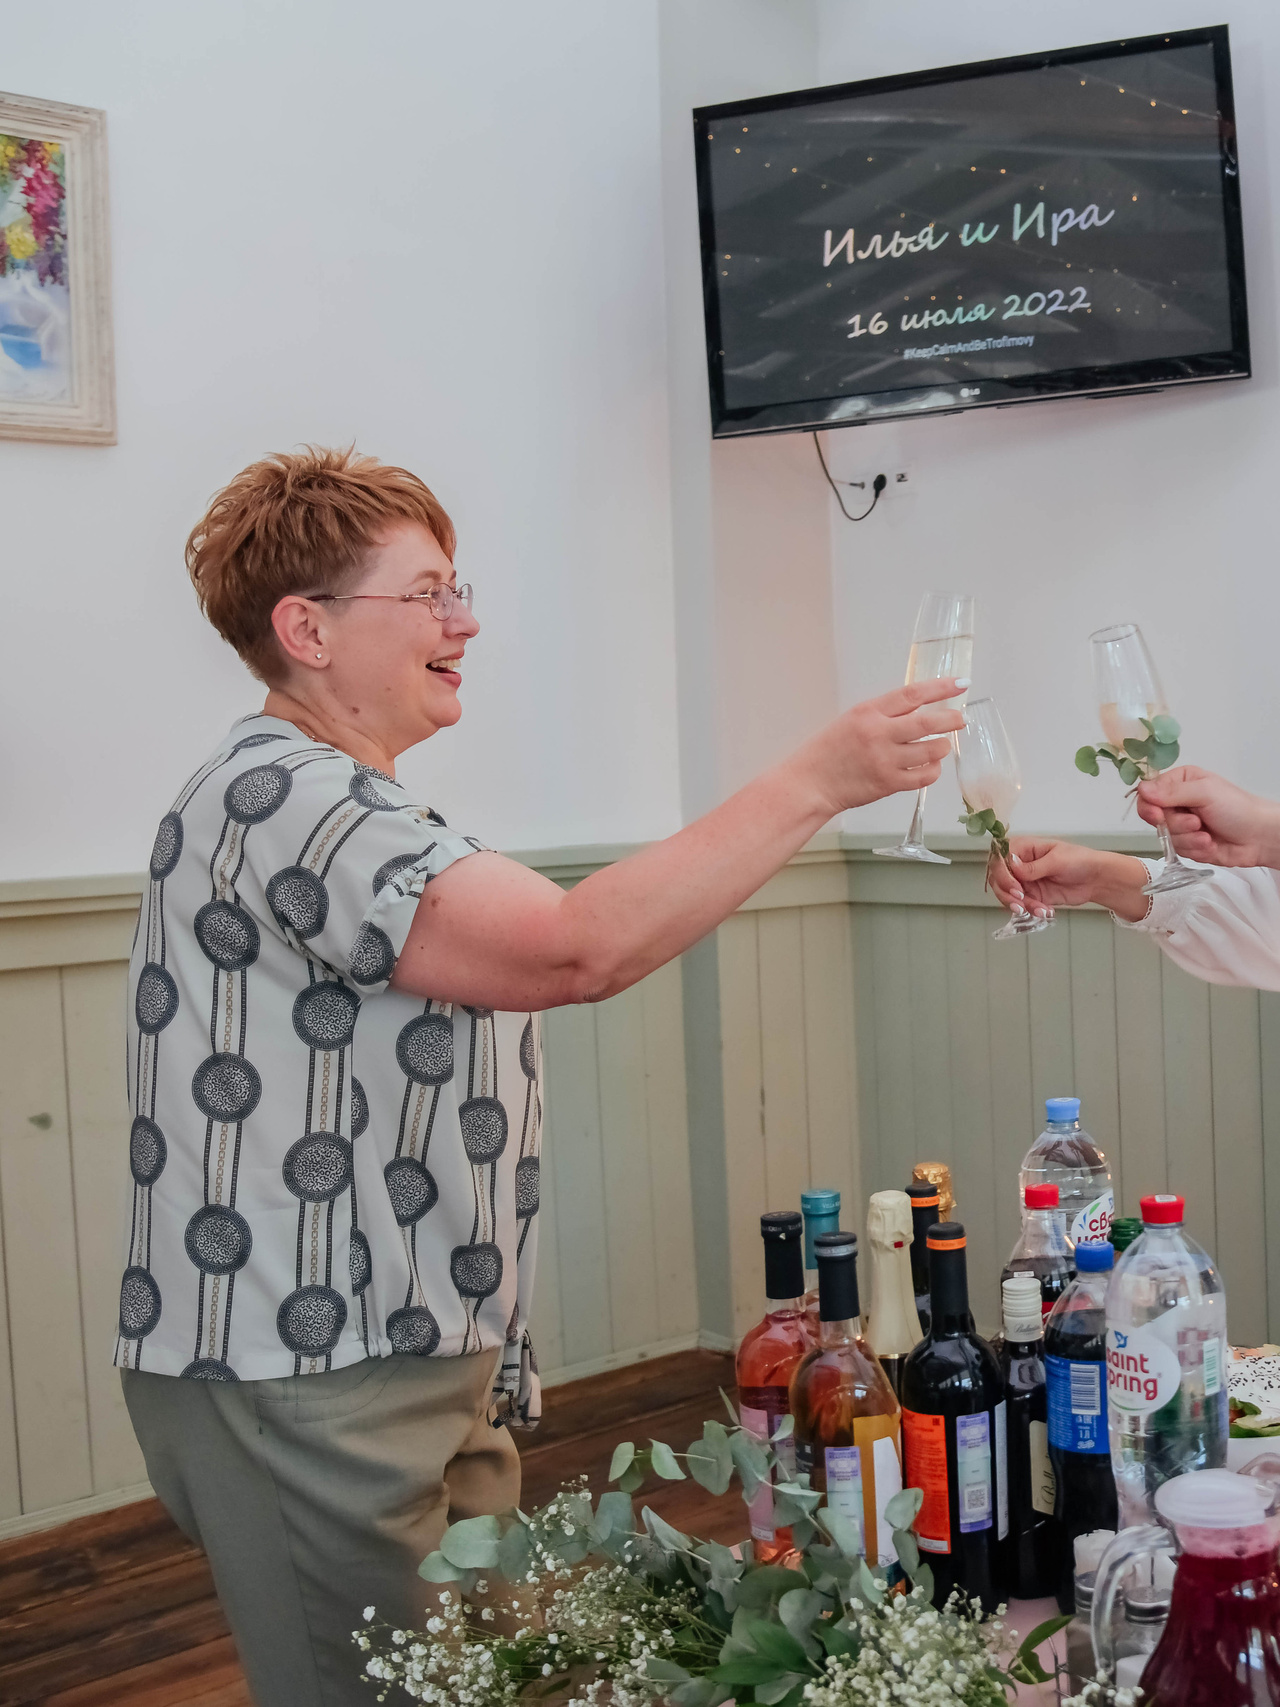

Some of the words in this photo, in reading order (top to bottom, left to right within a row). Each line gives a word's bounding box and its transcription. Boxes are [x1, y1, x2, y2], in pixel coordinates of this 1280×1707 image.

[823, 226, 949, 267] Илья
[959, 221, 1000, 247] и
[1012, 202, 1115, 246] Ира
[847, 312, 888, 338] 16
[900, 303, 997, 331] июля
[1001, 287, 1092, 320] 2022
[903, 335, 1035, 359] #KeepCalmAndBeTrofimovy
